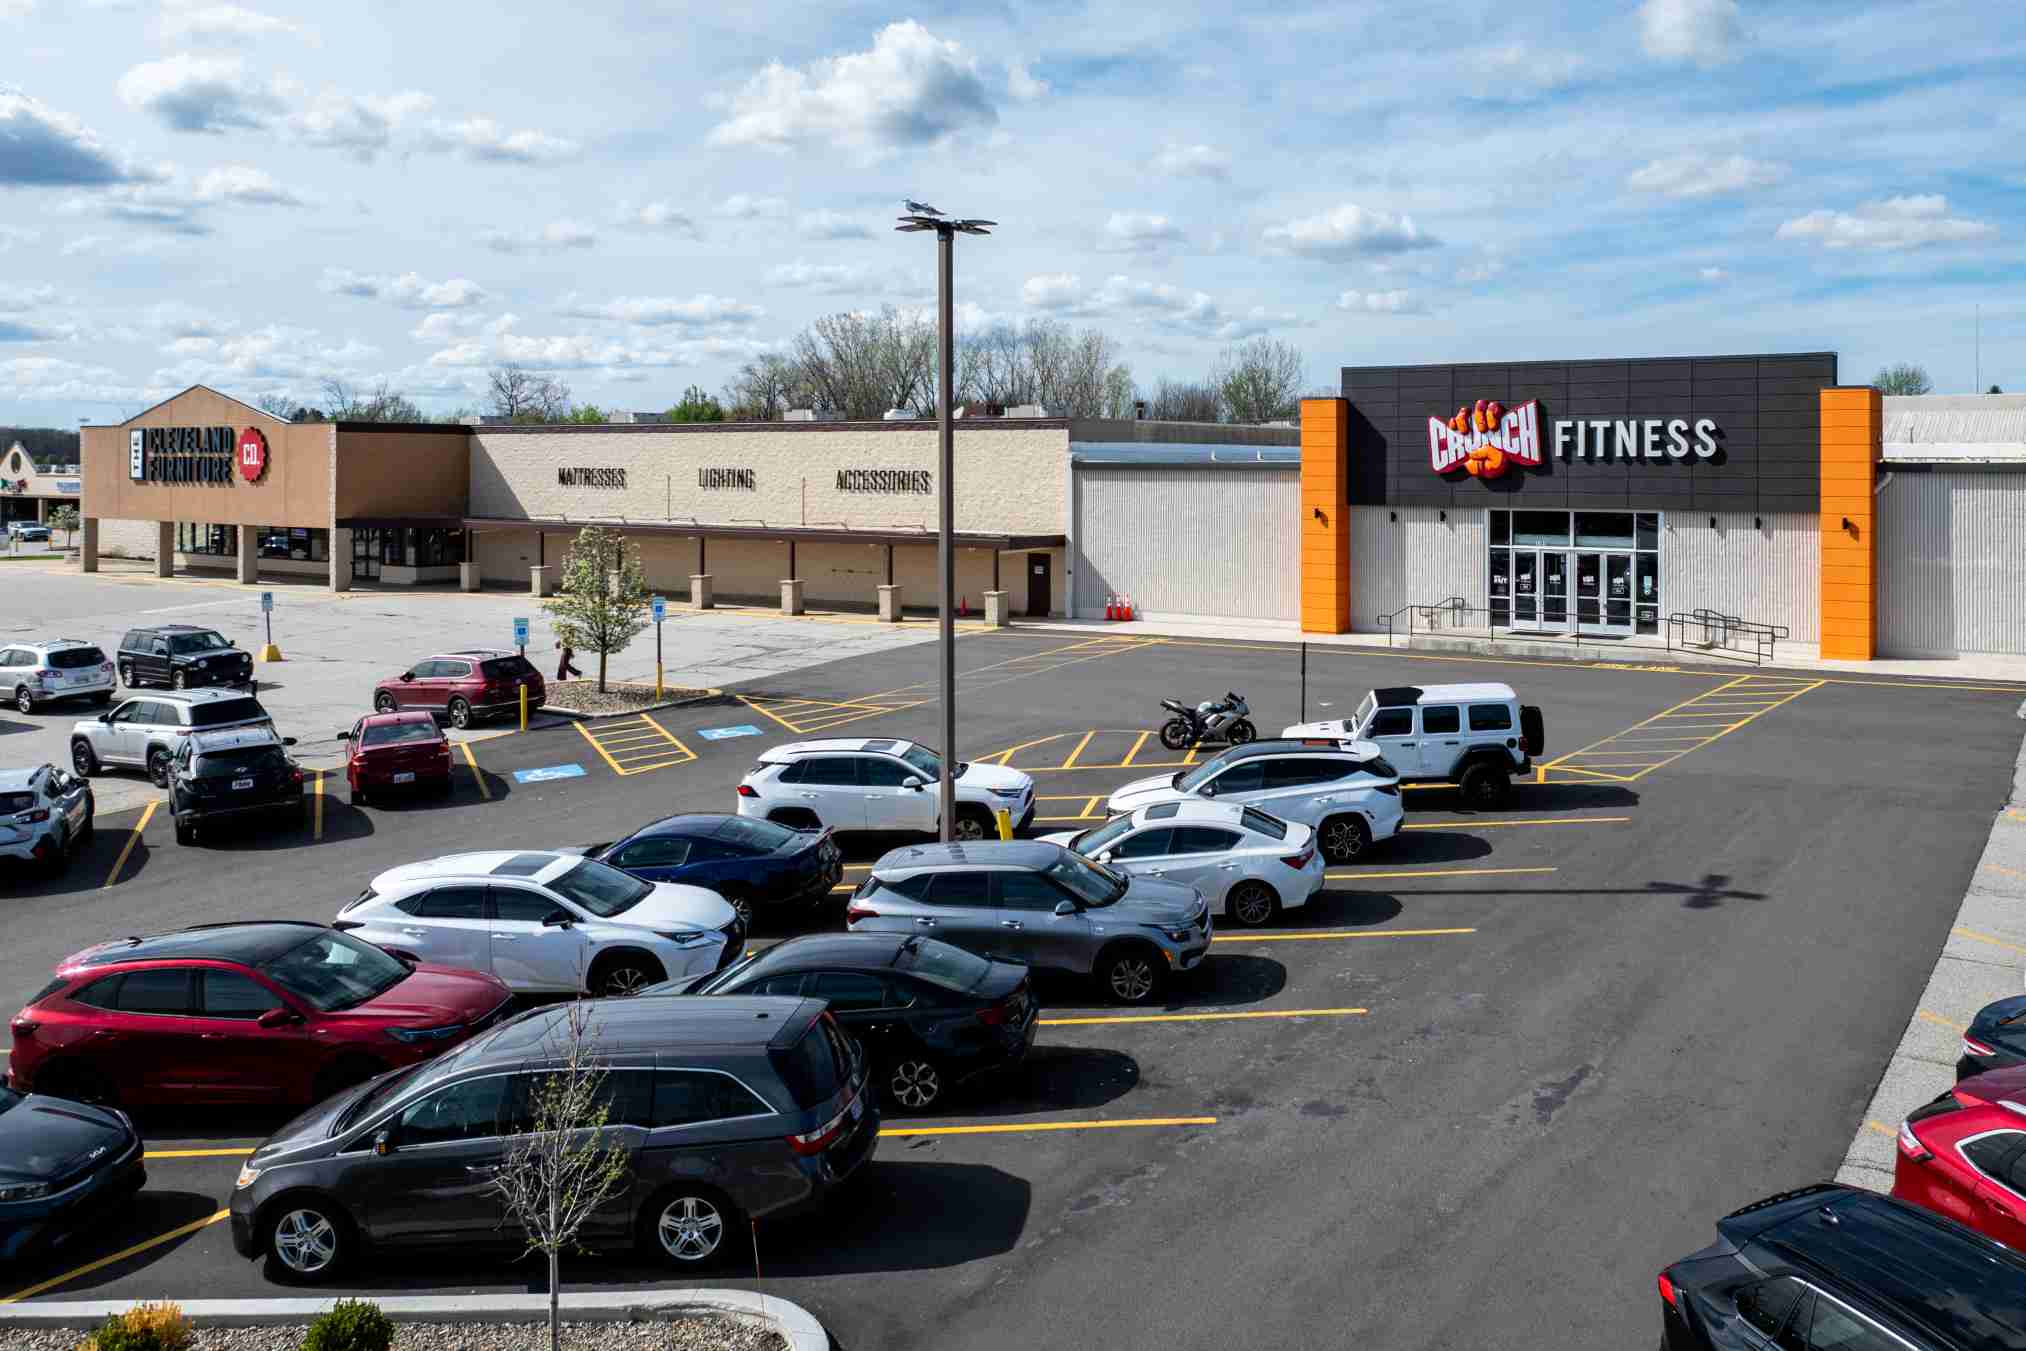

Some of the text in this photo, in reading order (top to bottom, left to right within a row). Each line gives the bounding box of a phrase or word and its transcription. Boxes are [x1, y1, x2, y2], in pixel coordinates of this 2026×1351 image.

[146, 427, 233, 452] CLEVELAND
[1555, 419, 1717, 458] FITNESS
[243, 443, 260, 465] CO.
[146, 457, 232, 481] FURNITURE
[558, 467, 626, 487] MATTRESSES
[699, 468, 754, 489] LIGHTING
[836, 469, 931, 492] ACCESSORIES
